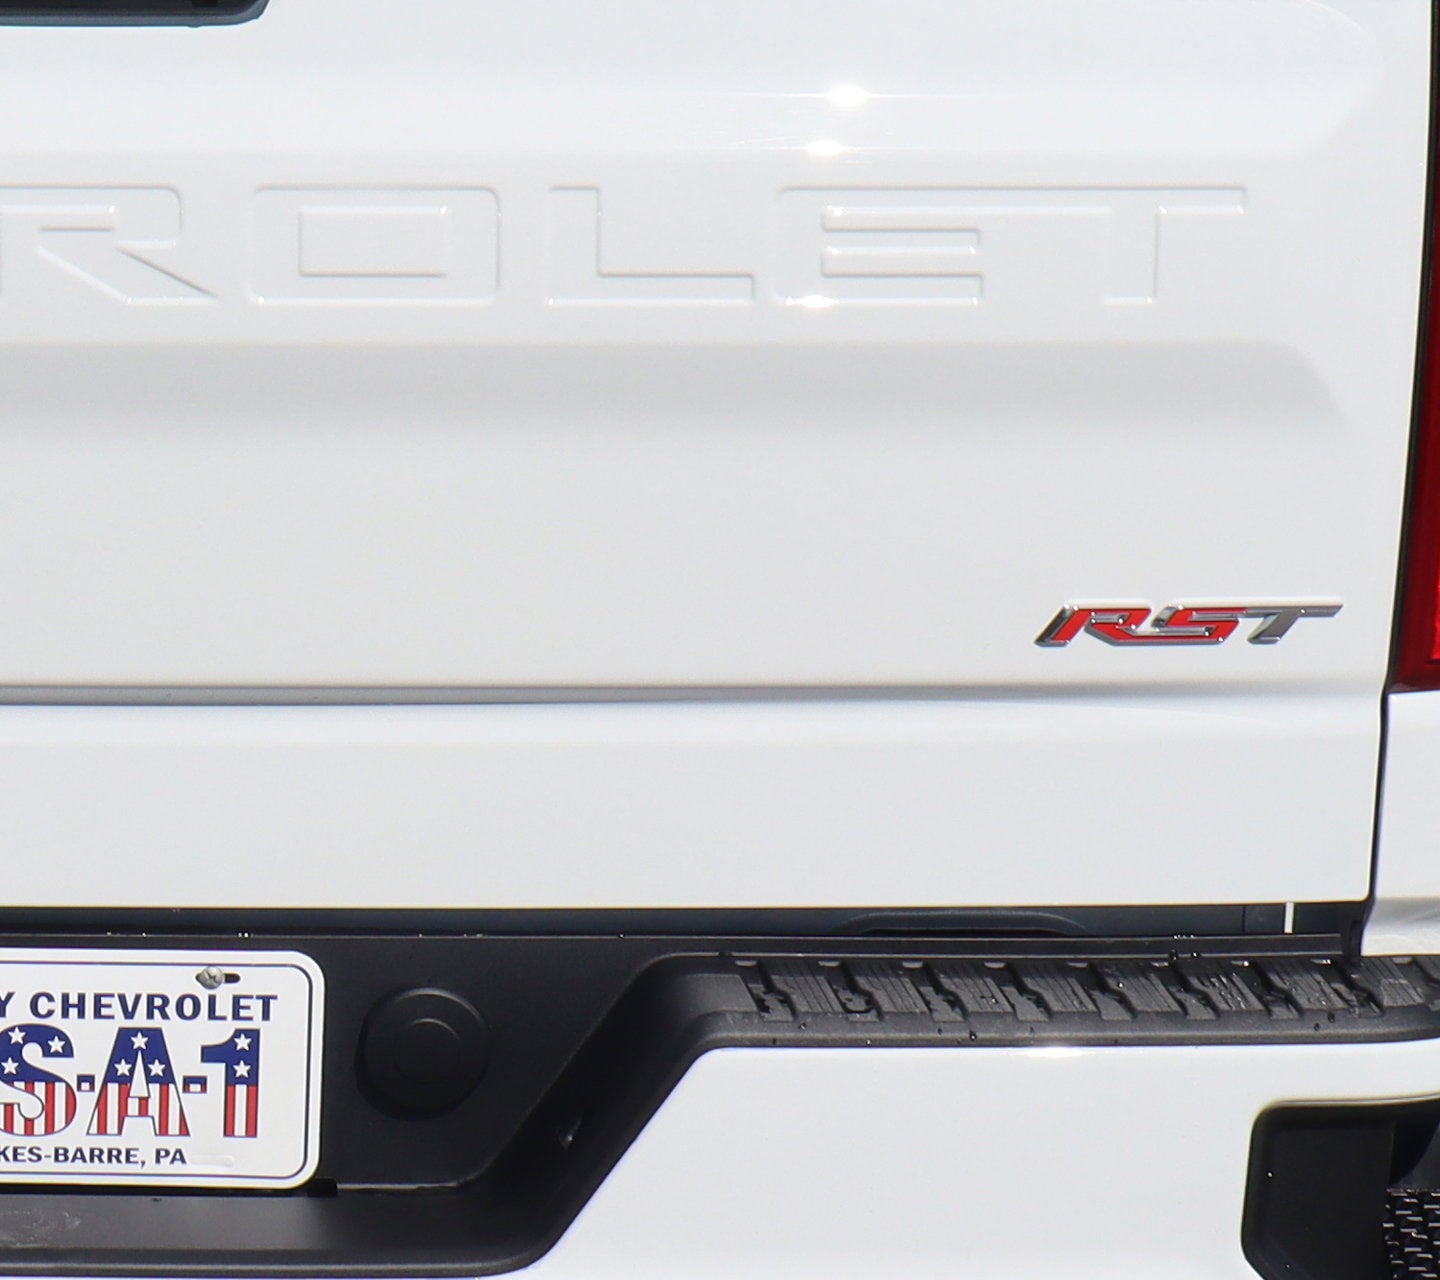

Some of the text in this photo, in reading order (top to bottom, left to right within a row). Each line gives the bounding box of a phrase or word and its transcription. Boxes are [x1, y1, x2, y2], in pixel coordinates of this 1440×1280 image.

[1034, 604, 1344, 647] RST
[28, 991, 278, 1022] CHEVROLET
[154, 1148, 188, 1166] PA
